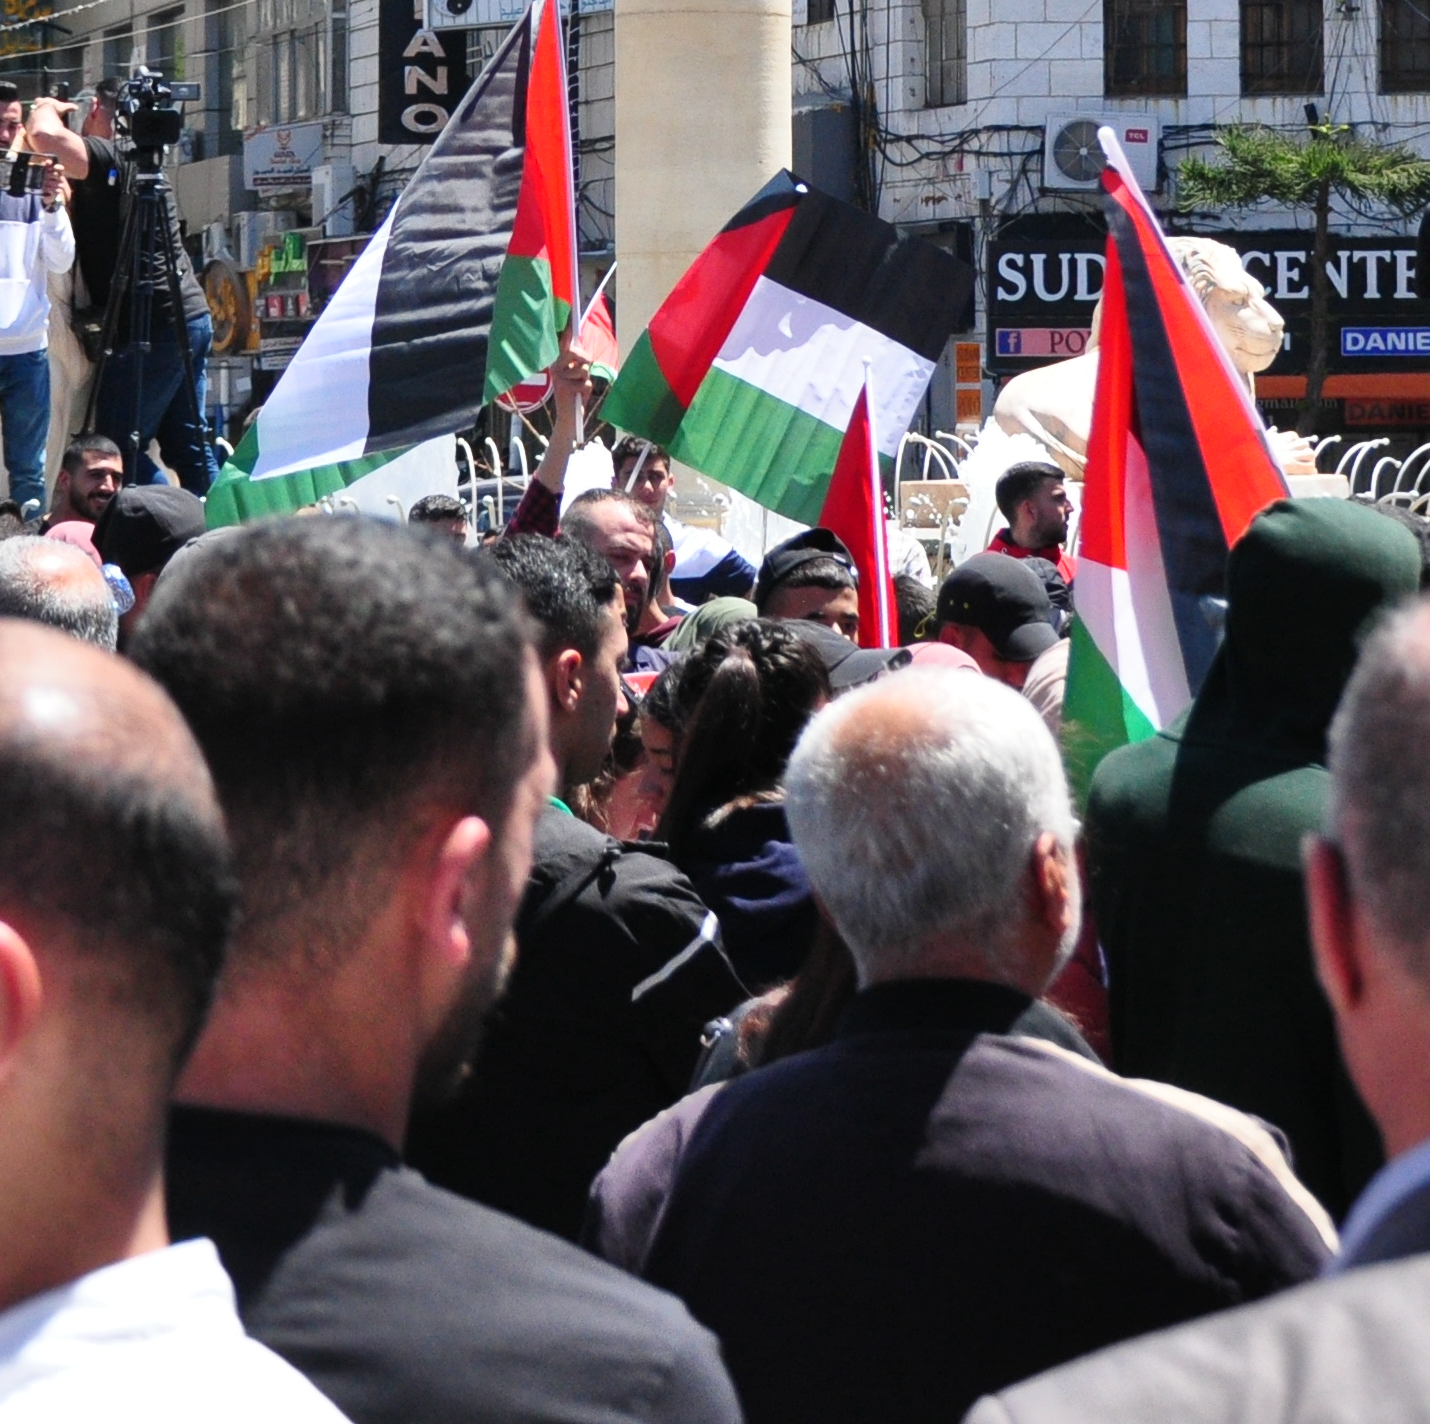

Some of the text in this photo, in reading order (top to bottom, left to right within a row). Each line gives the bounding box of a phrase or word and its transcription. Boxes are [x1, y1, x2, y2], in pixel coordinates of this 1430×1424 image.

[1128, 132, 1145, 140] TCL
[997, 250, 1430, 301] SUD CENTE
[1049, 330, 1092, 354] PO
